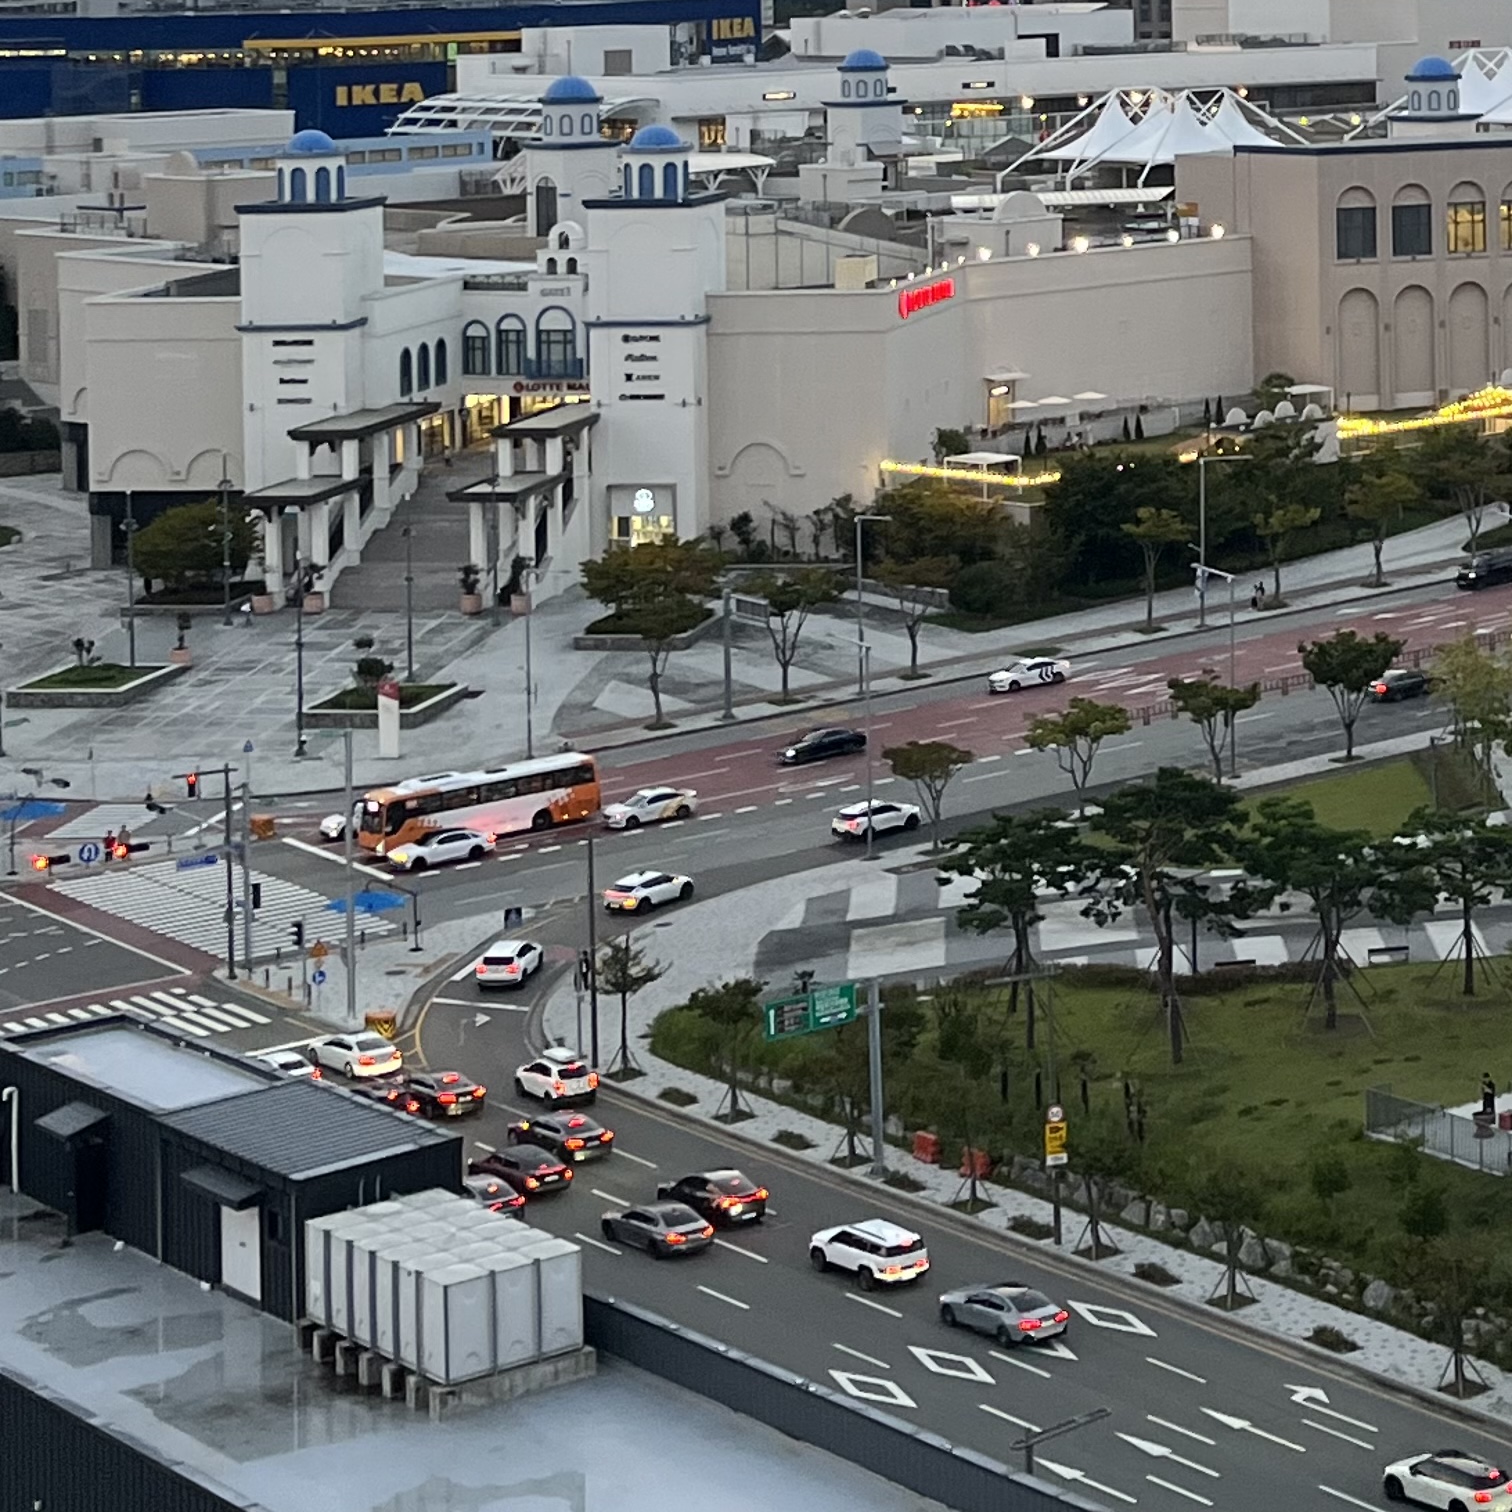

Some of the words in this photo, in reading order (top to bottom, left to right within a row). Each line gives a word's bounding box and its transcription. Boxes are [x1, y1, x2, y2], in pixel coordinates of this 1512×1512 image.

[711, 16, 756, 41] IKEA
[335, 82, 425, 106] IKEA
[525, 381, 564, 392] LOTTE
[566, 381, 591, 392] MAL
